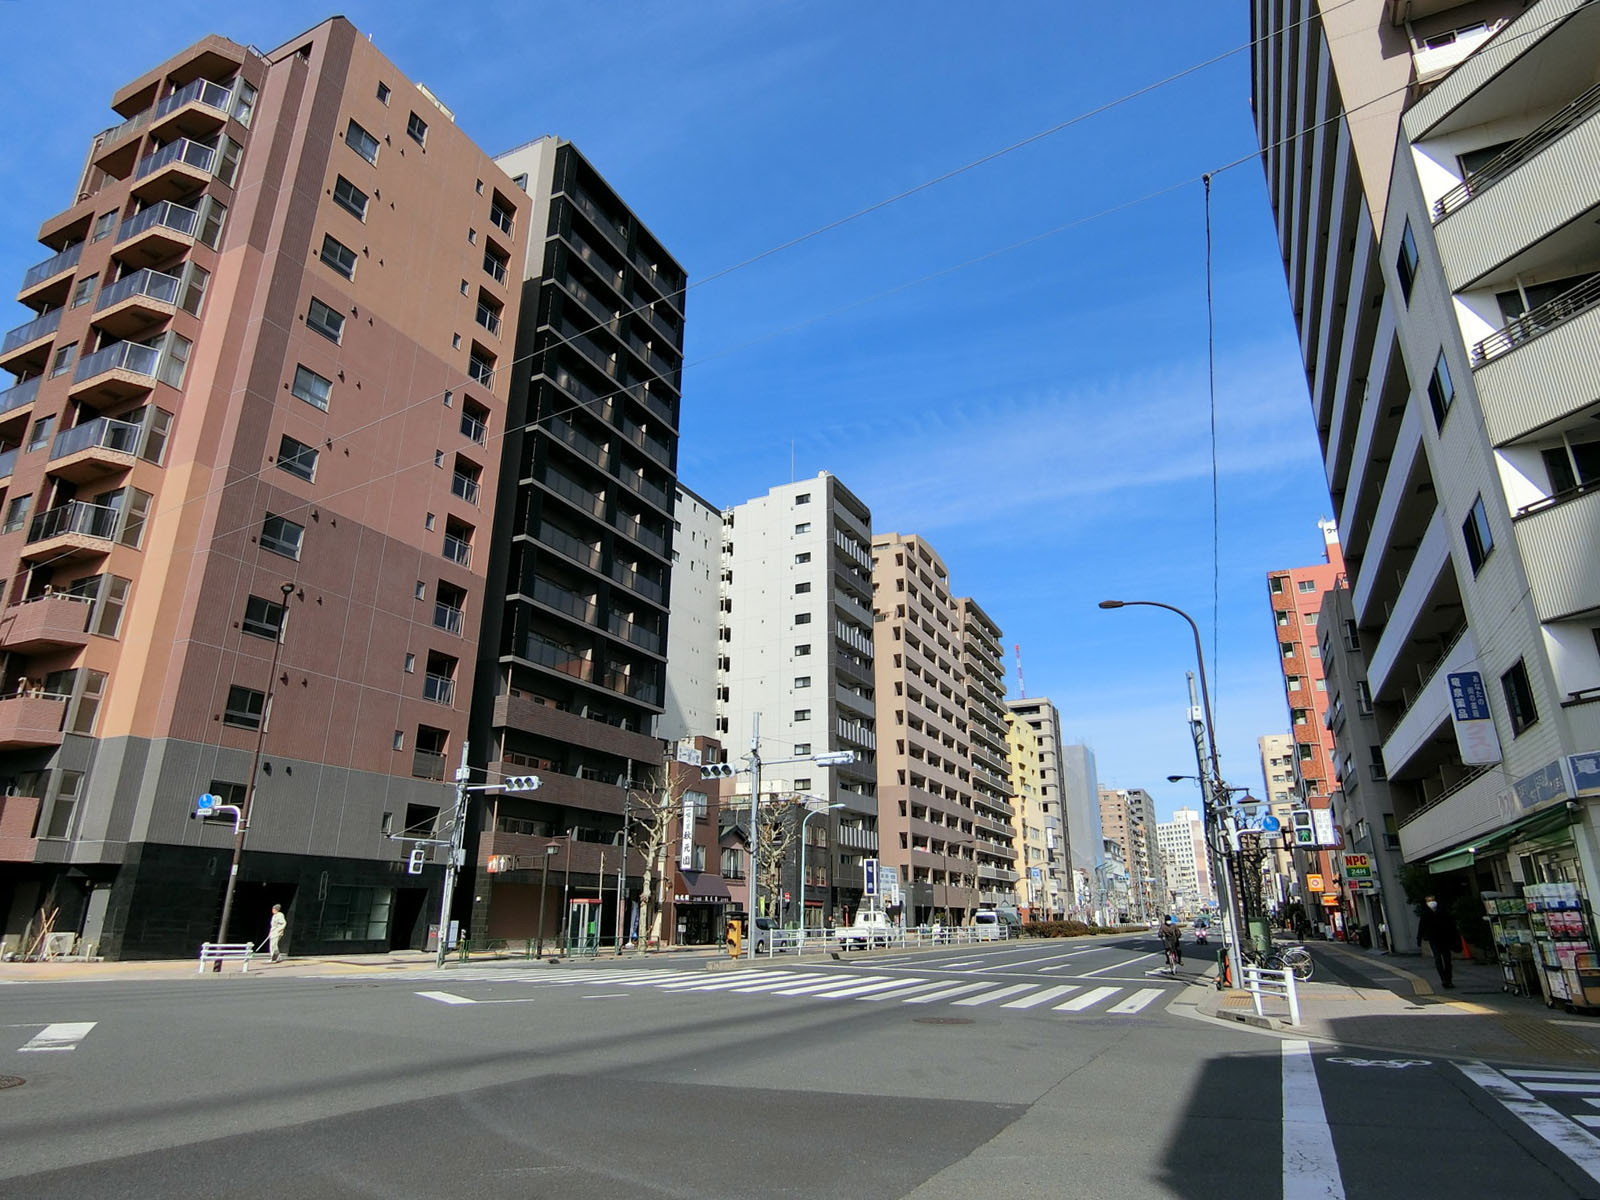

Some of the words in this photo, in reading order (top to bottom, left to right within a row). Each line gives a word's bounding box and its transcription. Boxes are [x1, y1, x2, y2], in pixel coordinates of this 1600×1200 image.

[1472, 675, 1485, 705] あなたの
[1345, 855, 1367, 866] NPC
